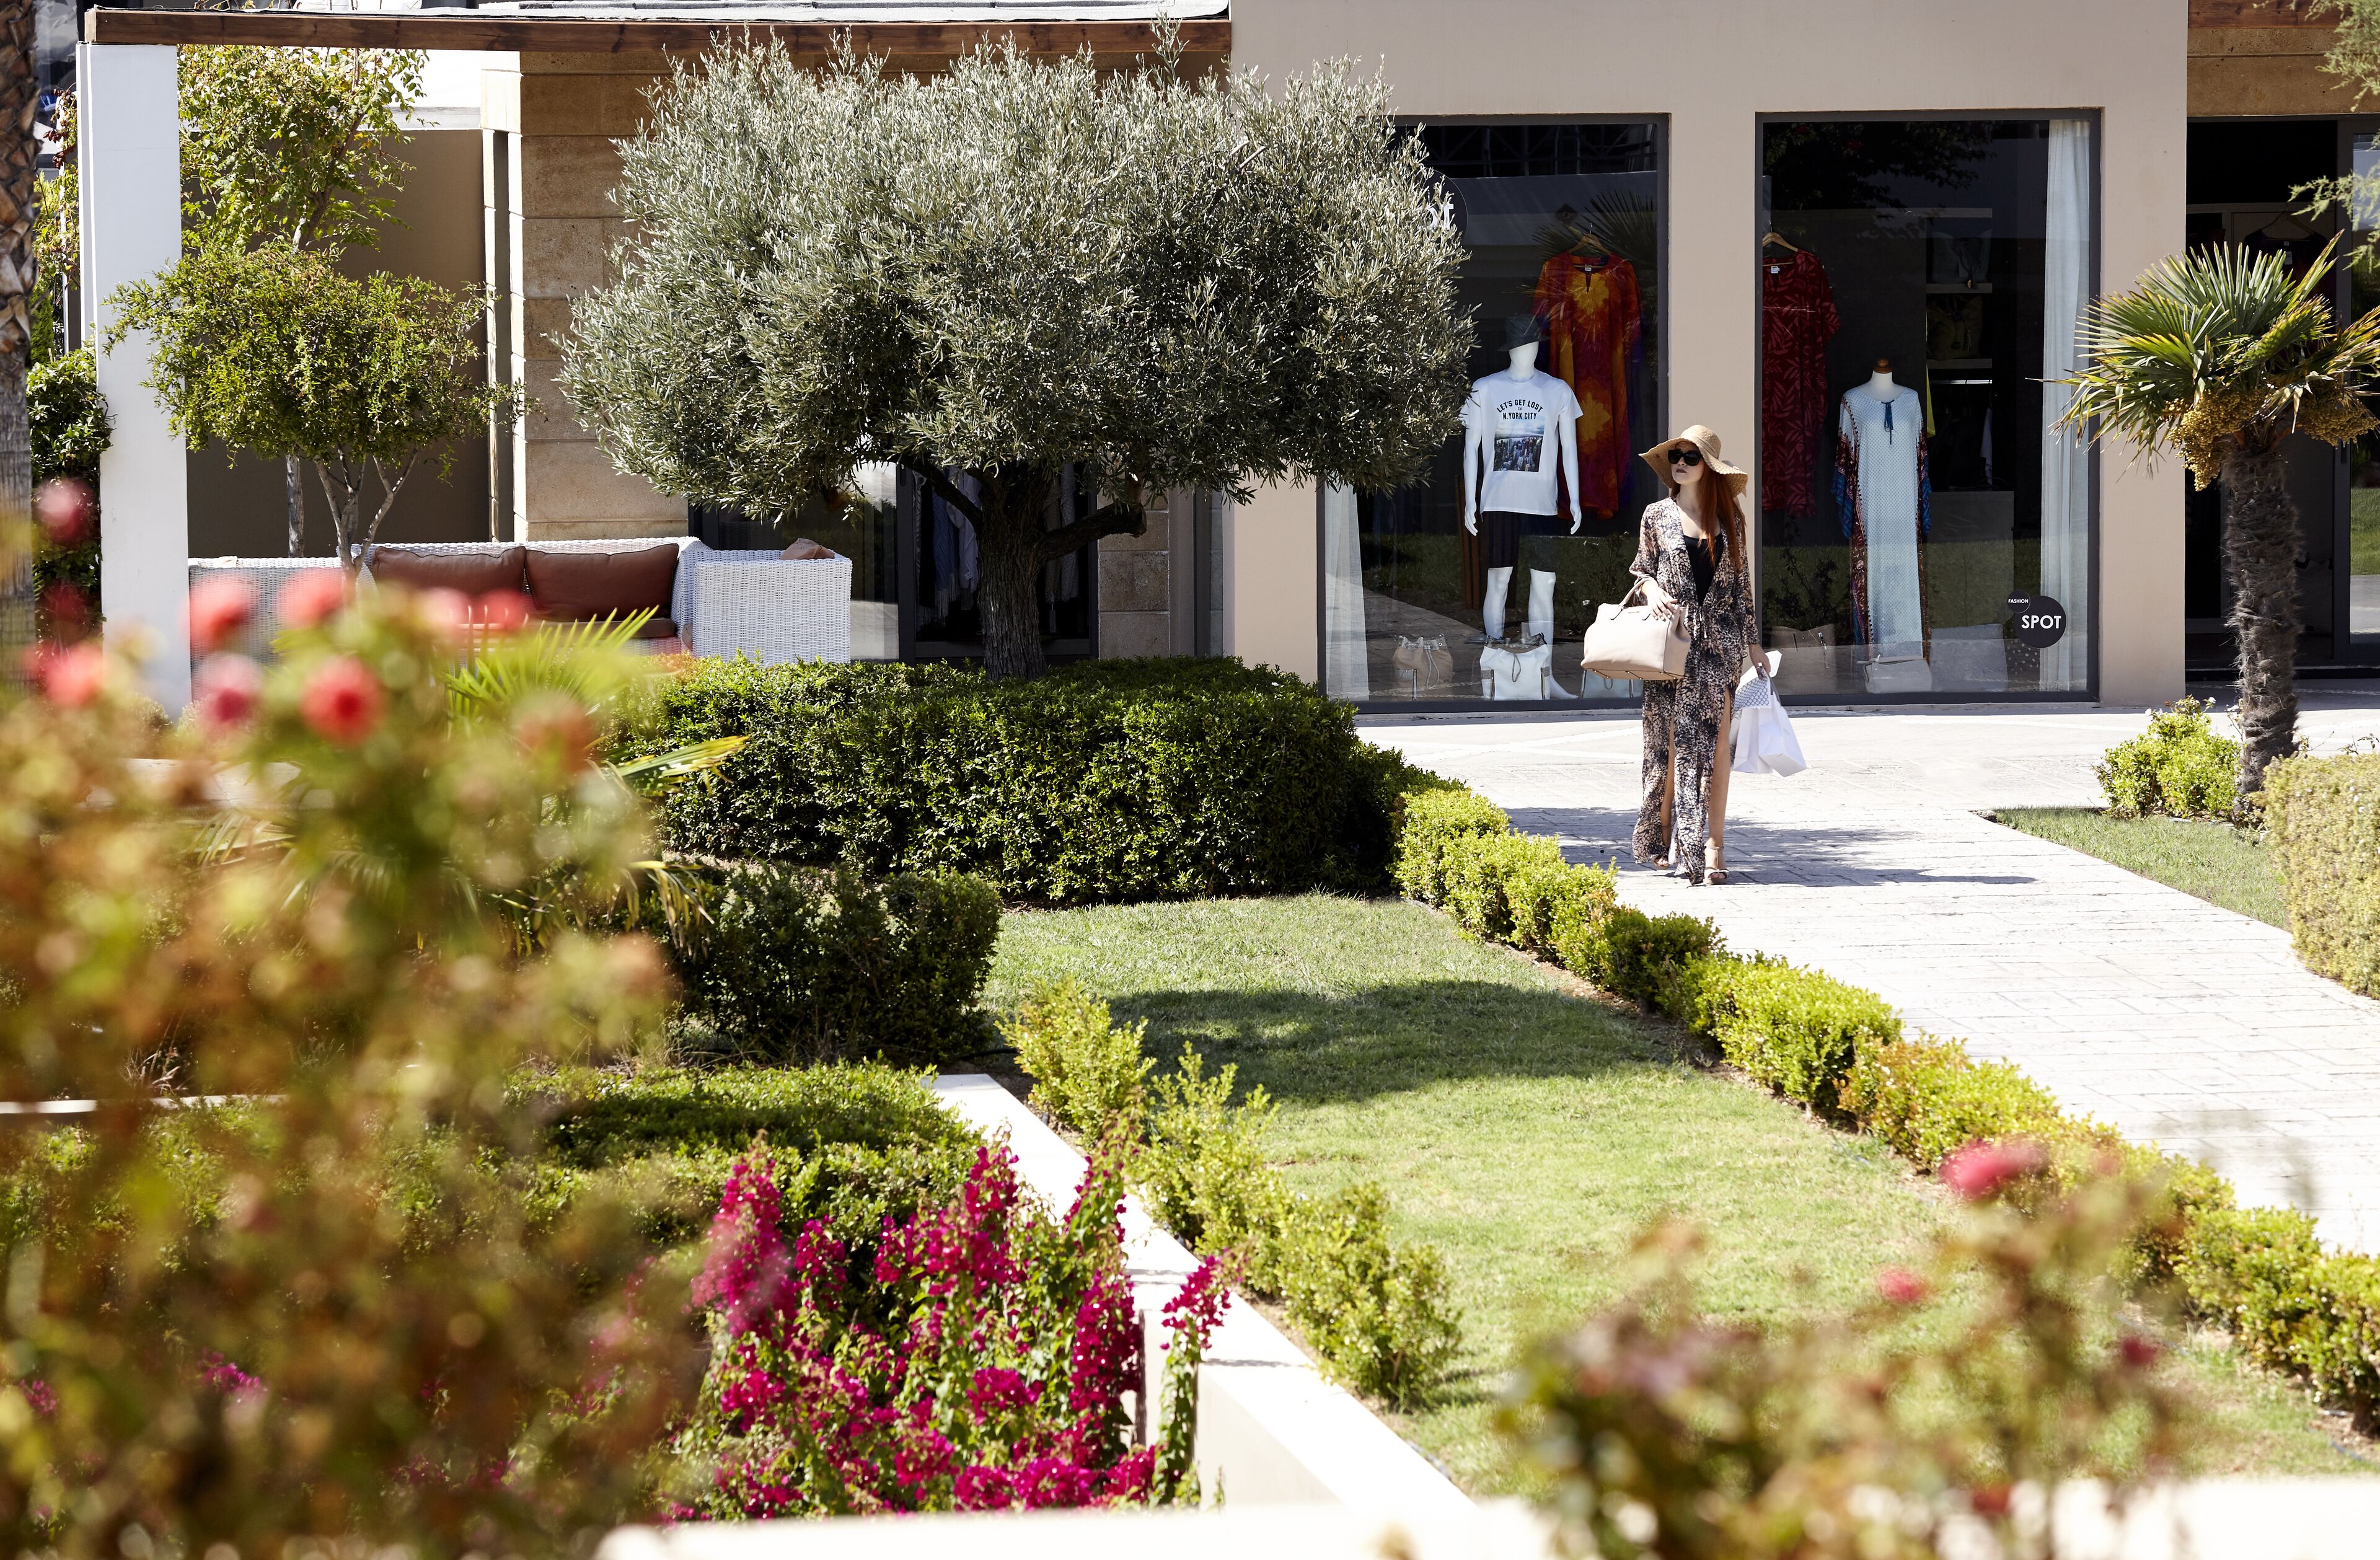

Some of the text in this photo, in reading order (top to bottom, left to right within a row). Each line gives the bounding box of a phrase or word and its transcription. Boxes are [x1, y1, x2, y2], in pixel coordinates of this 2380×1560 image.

[1496, 400, 1513, 413] LET'S
[1527, 400, 1543, 412] LOST
[2021, 615, 2062, 629] SPOT
